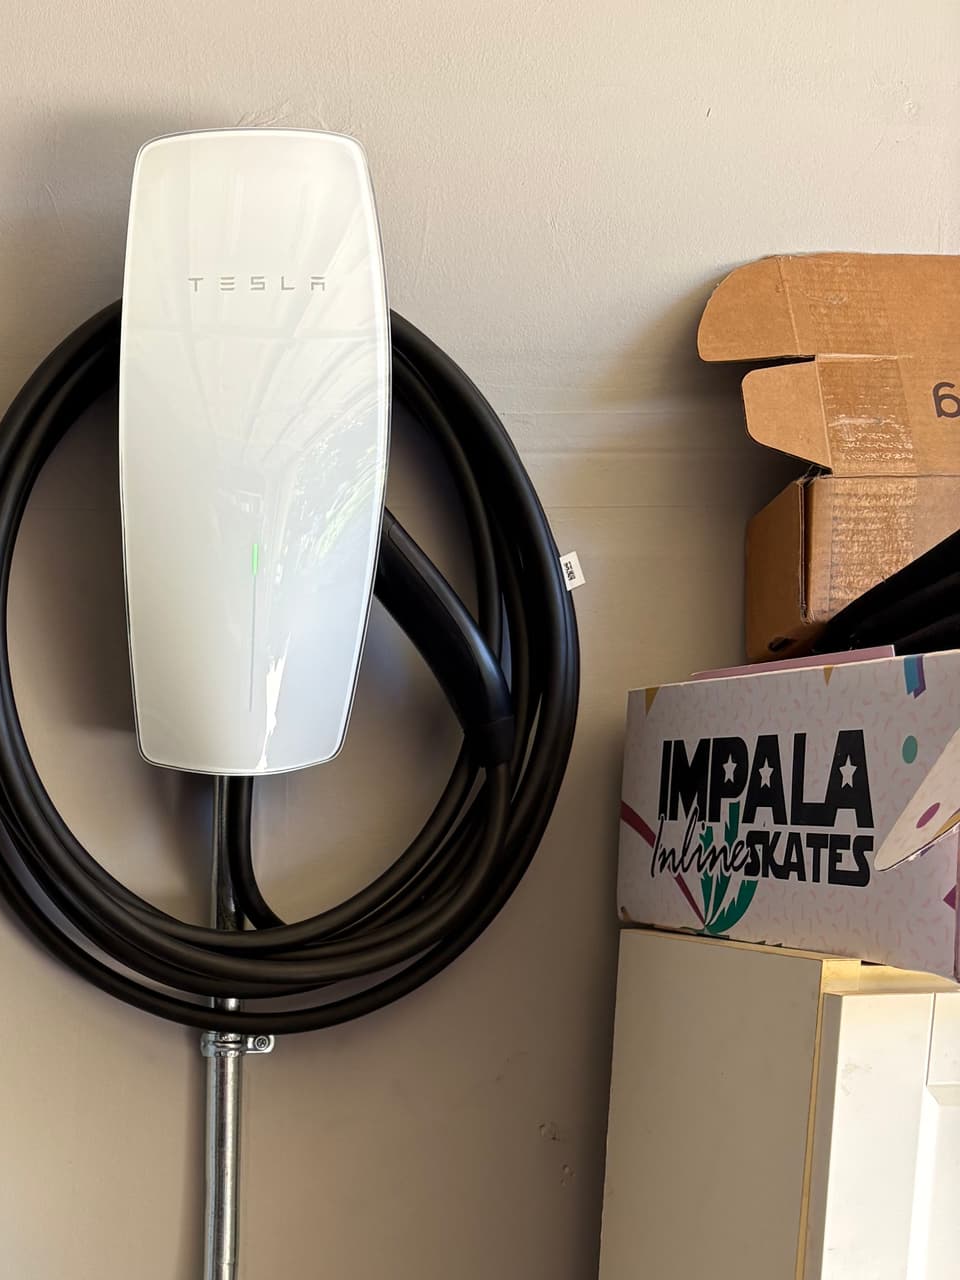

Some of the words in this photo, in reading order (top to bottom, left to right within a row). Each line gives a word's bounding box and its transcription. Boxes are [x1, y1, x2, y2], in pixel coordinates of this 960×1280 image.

[188, 275, 325, 292] TESLA
[658, 729, 874, 828] IMPALA
[650, 805, 750, 878] Inline
[743, 829, 874, 887] SKATES
